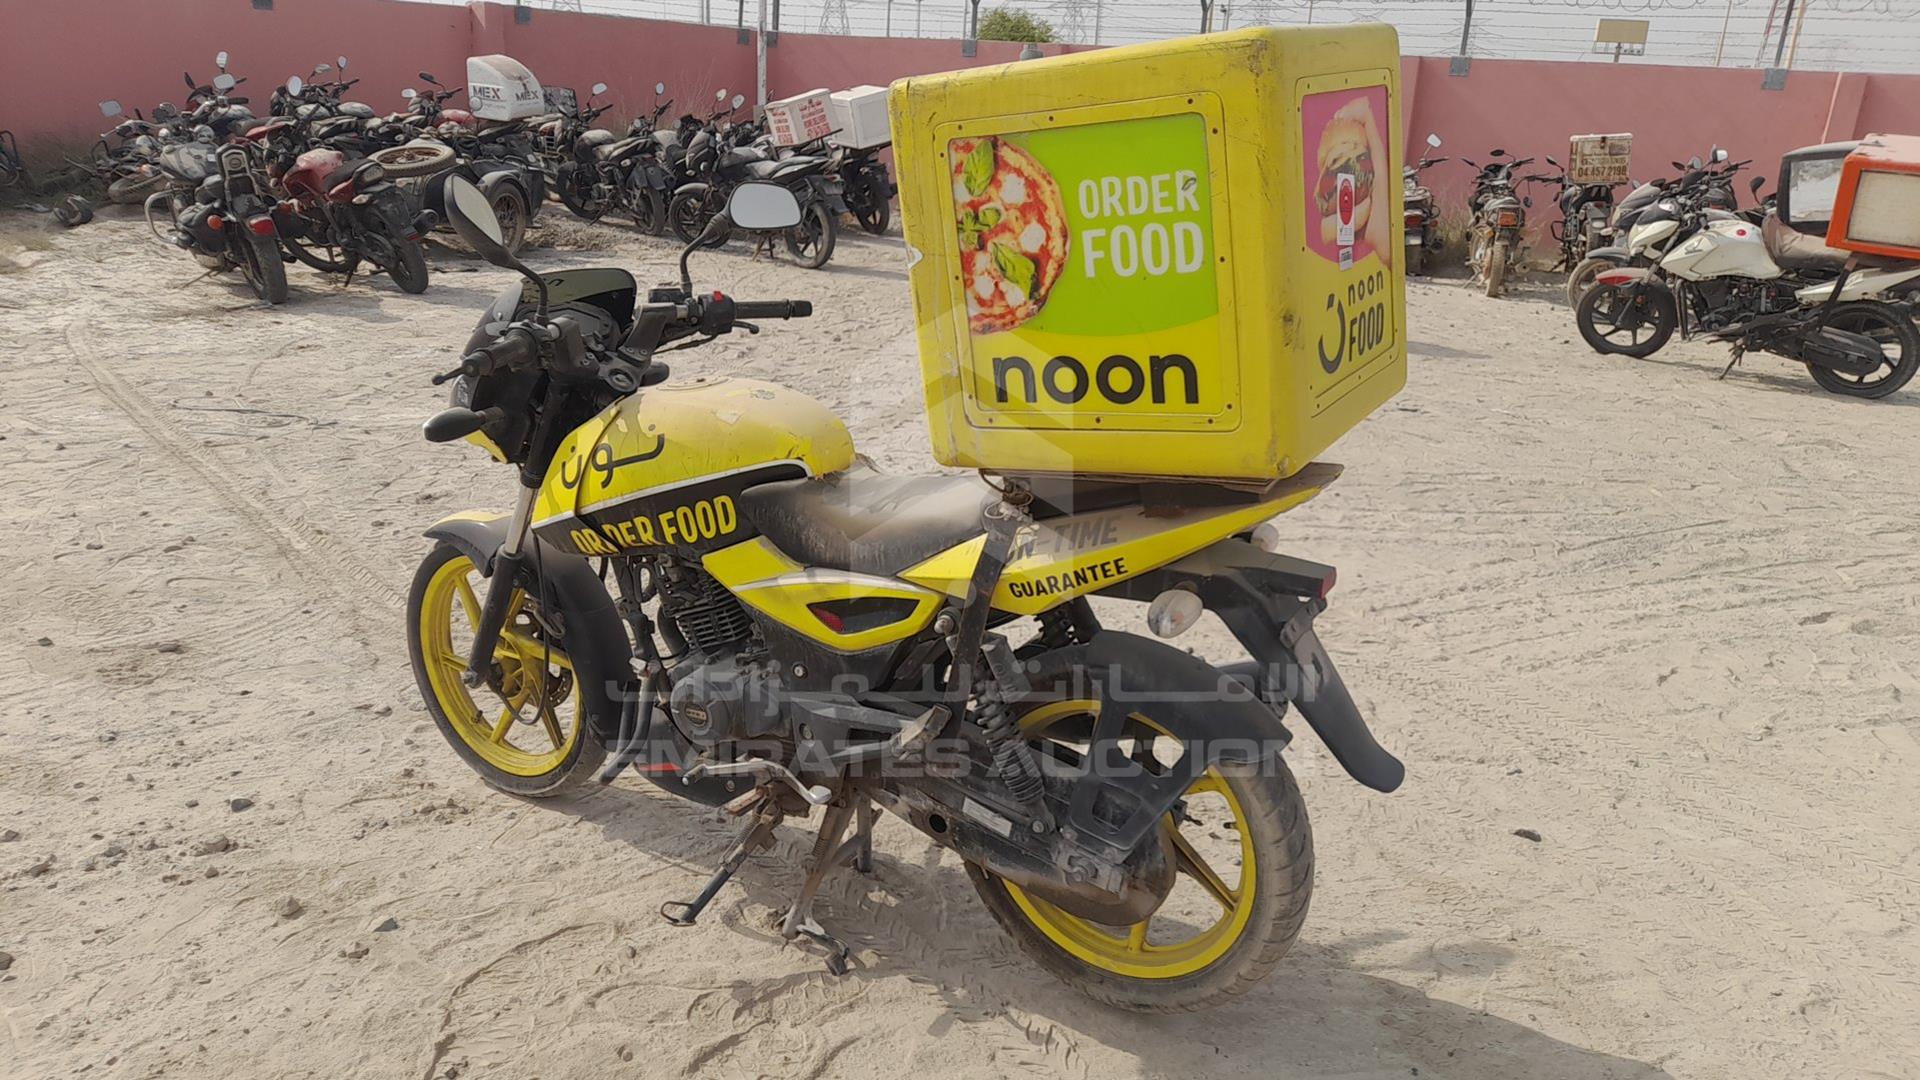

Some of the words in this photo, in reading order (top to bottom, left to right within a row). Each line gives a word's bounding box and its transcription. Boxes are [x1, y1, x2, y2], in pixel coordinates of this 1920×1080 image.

[472, 86, 501, 100] MEX
[515, 90, 540, 101] MEX
[1079, 170, 1200, 220] ORDER
[1082, 222, 1205, 279] FOOD
[1348, 270, 1384, 307] noon
[1348, 302, 1385, 363] FOOD
[992, 354, 1200, 405] noon
[560, 423, 665, 490] نون
[570, 515, 664, 555] ORDER
[658, 494, 738, 546] FOOD
[1054, 513, 1125, 553] TIME
[1008, 557, 1129, 599] GUARANTEE
